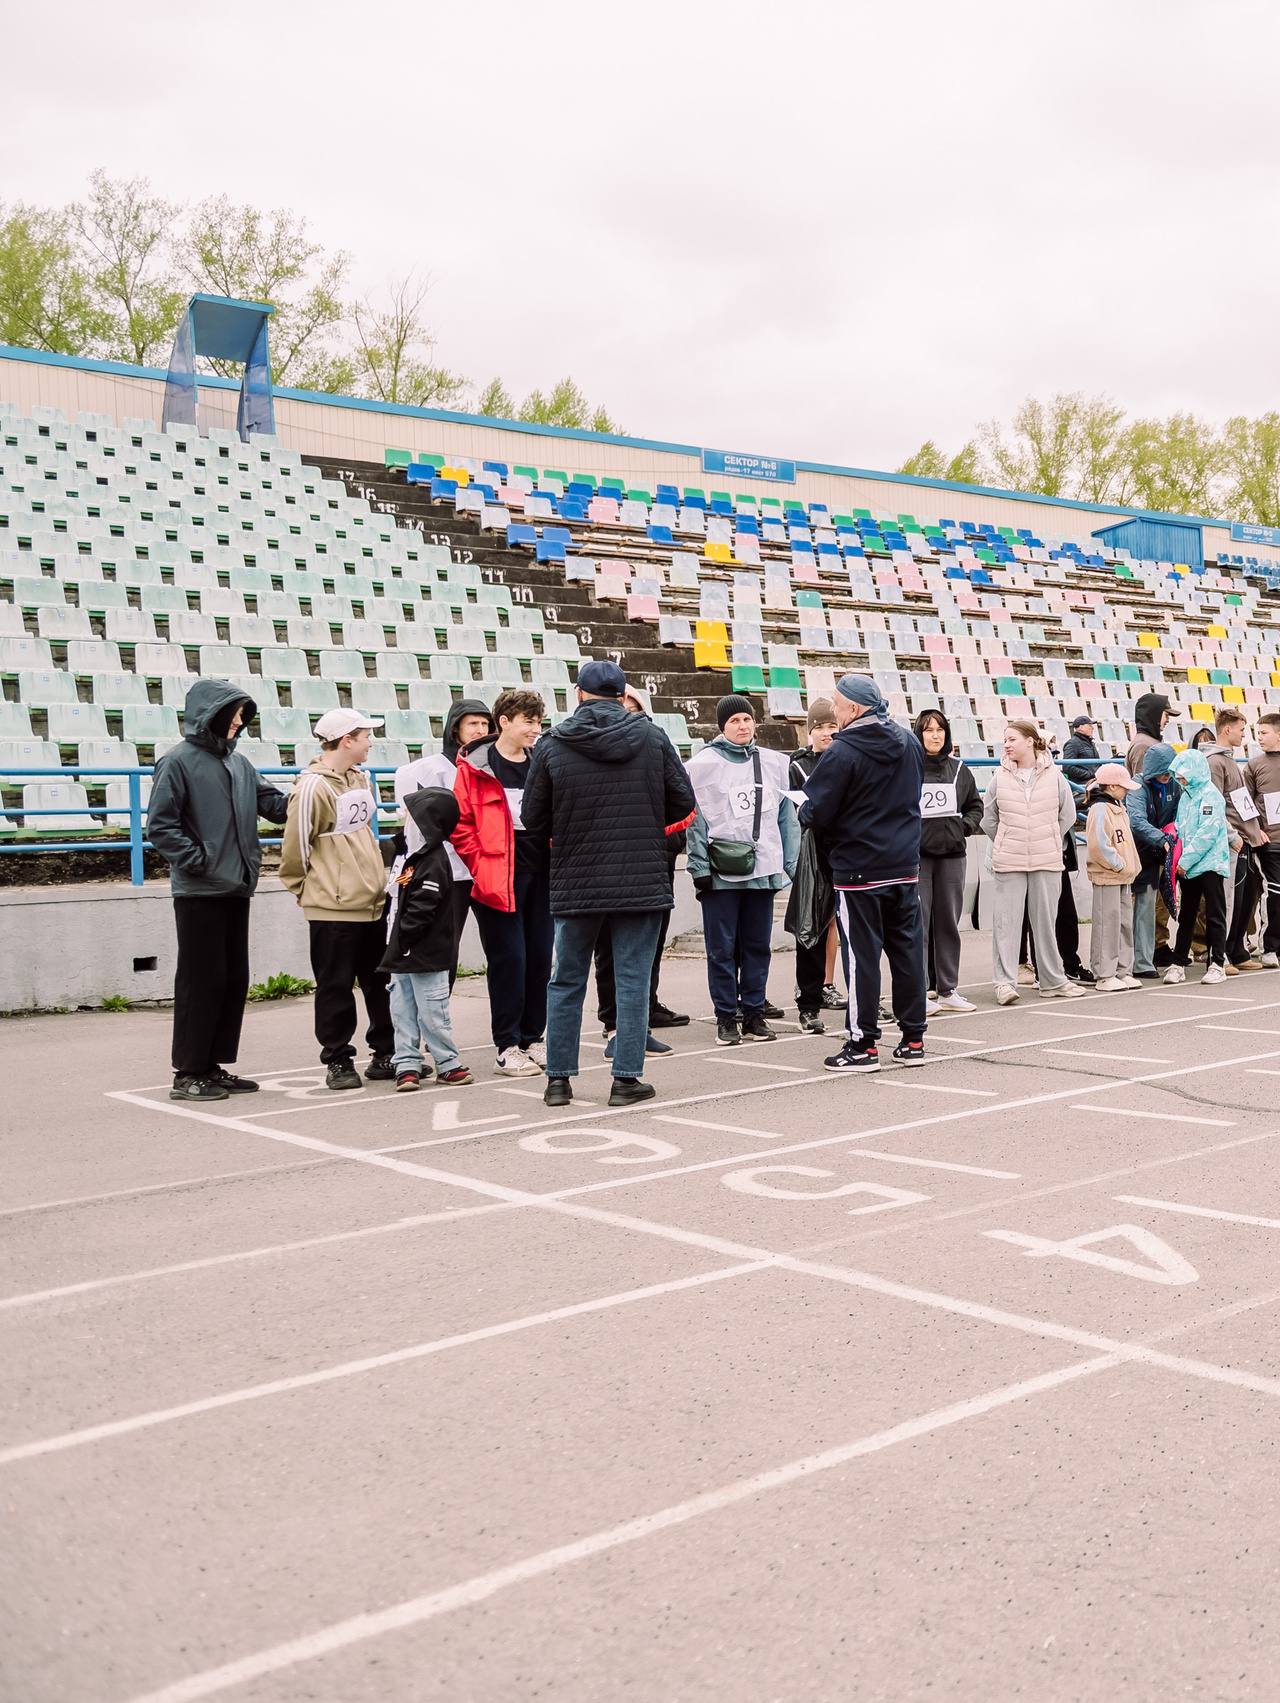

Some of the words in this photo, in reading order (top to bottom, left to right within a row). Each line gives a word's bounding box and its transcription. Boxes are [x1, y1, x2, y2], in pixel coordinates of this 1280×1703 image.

[724, 455, 759, 468] СЕКТОР
[337, 470, 355, 481] 17
[357, 486, 377, 500] 16
[453, 549, 474, 564] 12
[485, 569, 504, 584] 11
[512, 587, 534, 603] 10
[923, 790, 948, 809] 29
[349, 801, 368, 825] 23
[1115, 829, 1126, 844] R
[431, 1100, 522, 1131] 7
[518, 1128, 683, 1165] 6
[719, 1165, 933, 1215] 5
[982, 1223, 1200, 1286] 4
